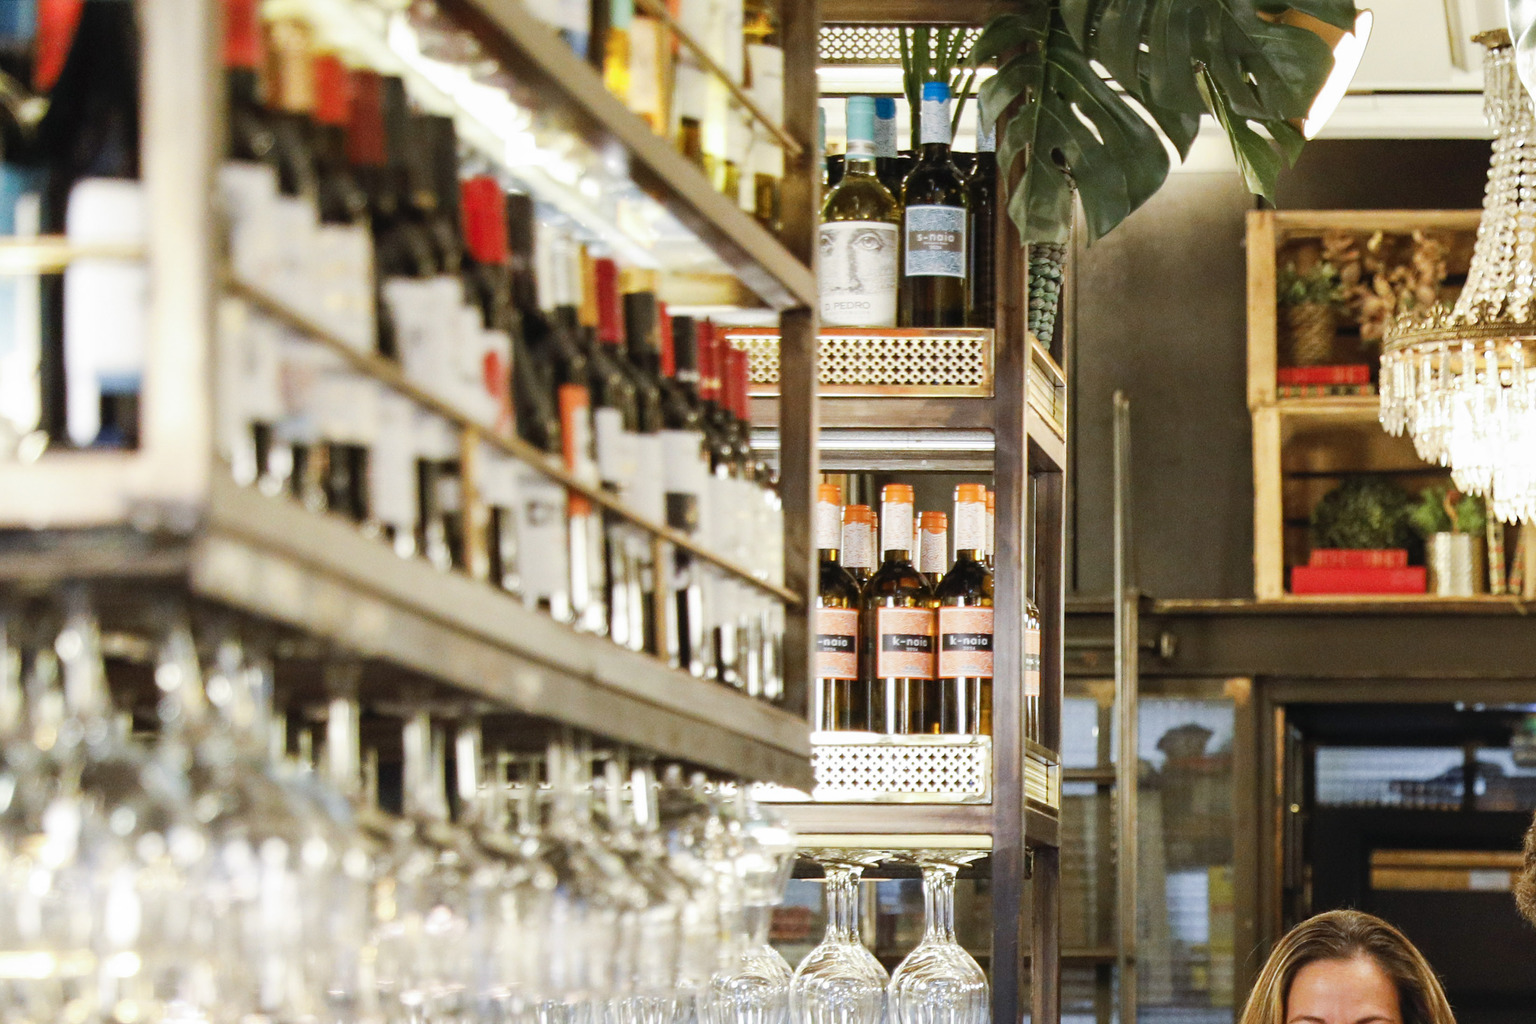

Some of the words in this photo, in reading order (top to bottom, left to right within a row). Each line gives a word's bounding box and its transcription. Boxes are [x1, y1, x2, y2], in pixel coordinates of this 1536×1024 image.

[834, 301, 870, 310] PEDRO
[817, 636, 848, 646] -naia
[950, 635, 988, 646] k-naia
